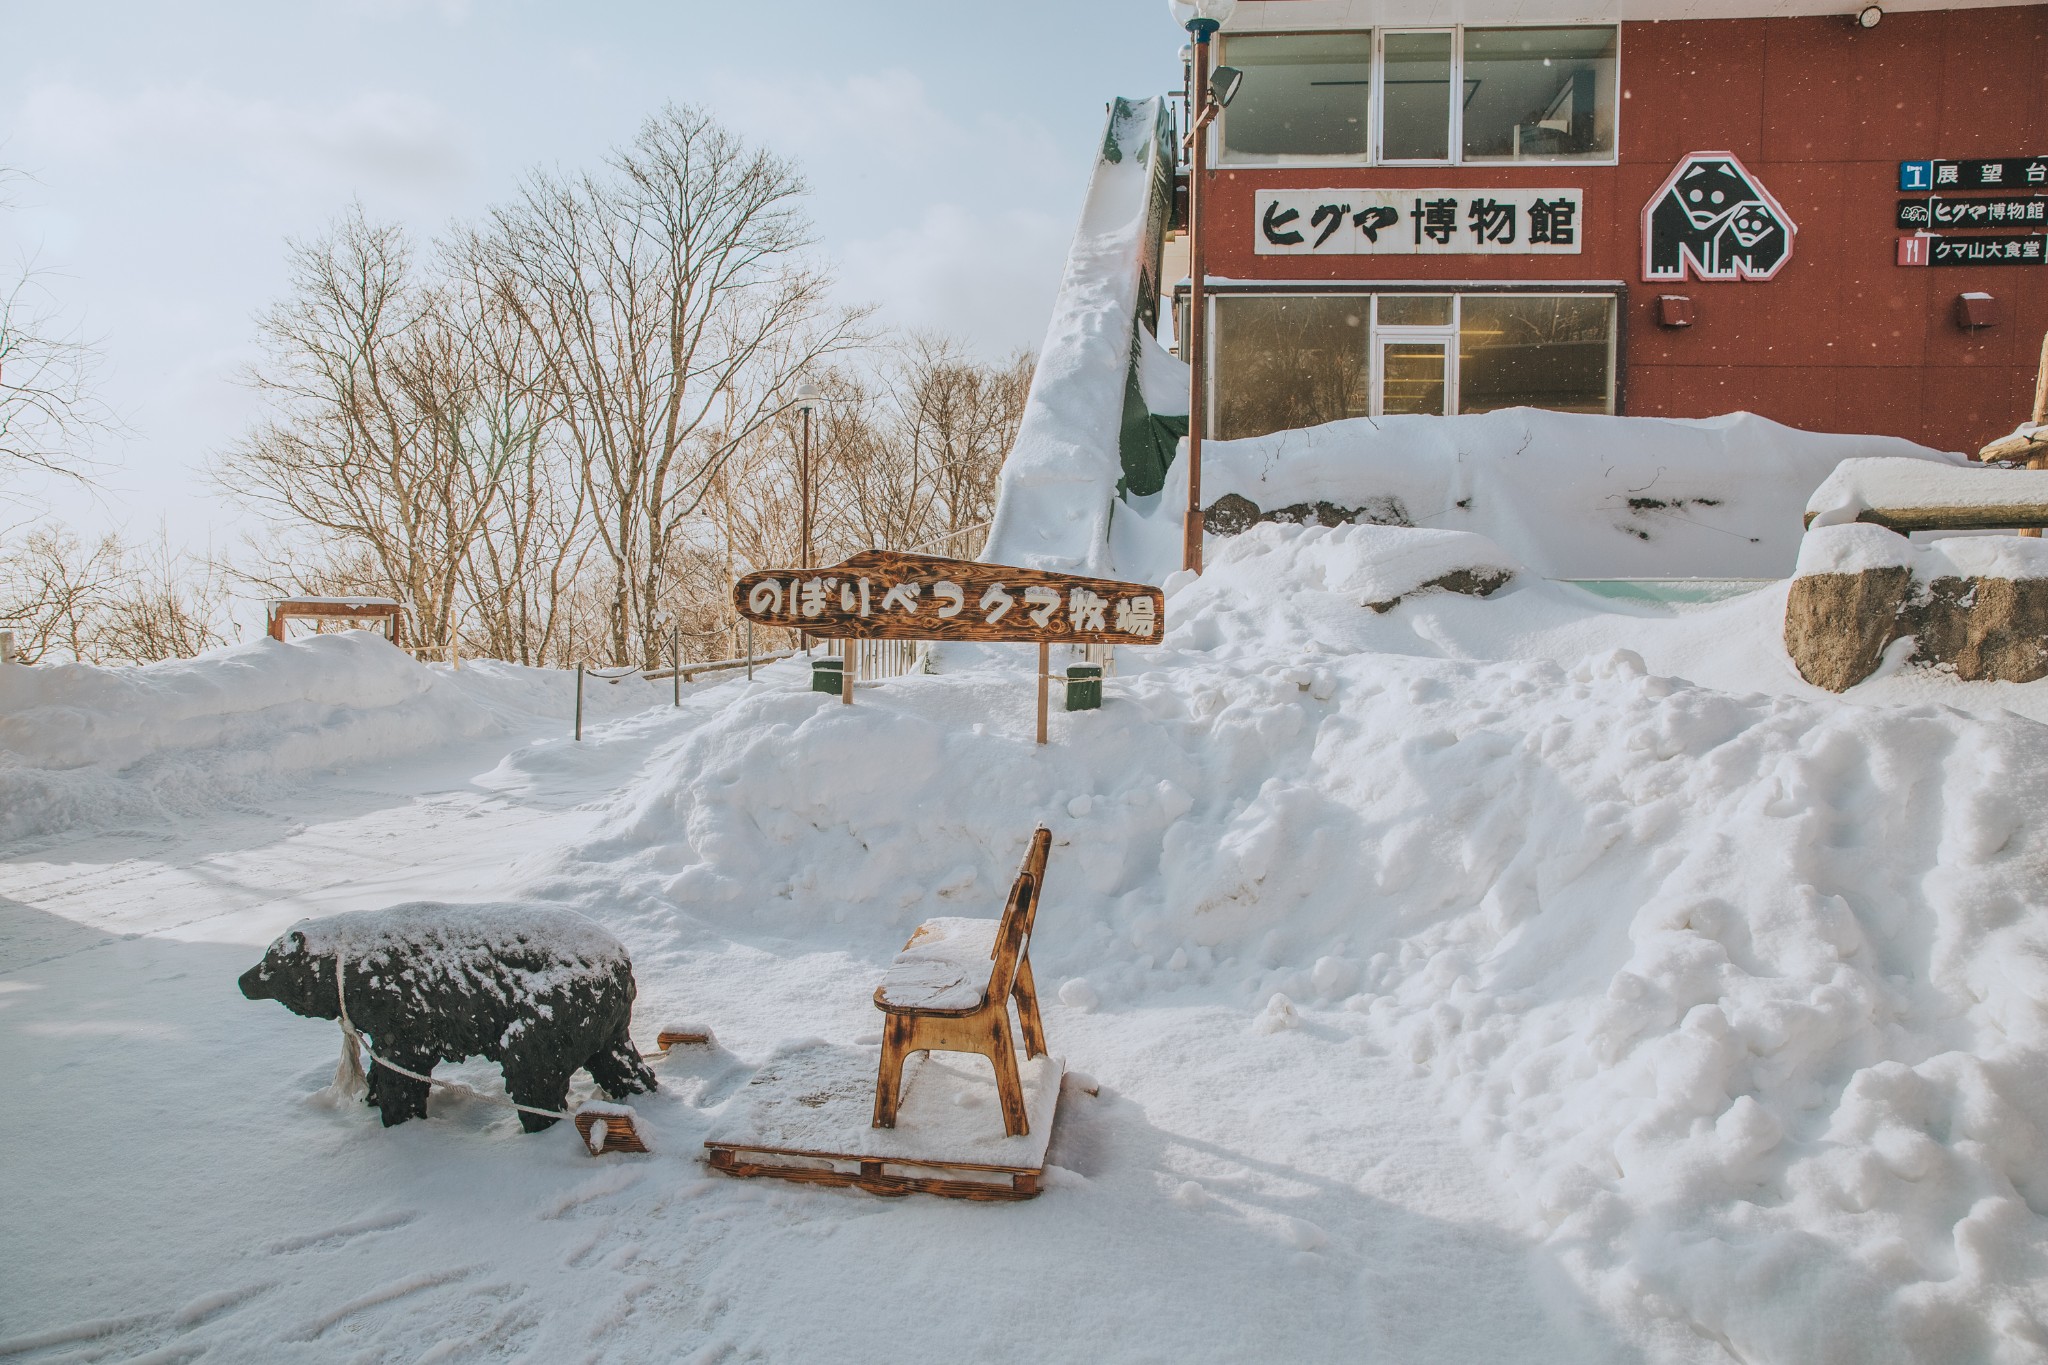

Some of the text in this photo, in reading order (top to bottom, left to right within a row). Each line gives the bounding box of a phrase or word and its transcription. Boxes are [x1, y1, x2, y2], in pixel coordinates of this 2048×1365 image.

[1937, 162, 2047, 184] 展望台
[1935, 201, 2044, 222] ヒグマ博物館
[1262, 197, 1574, 250] ヒグマ博物館
[1935, 241, 2040, 259] クマ山大食堂
[748, 576, 1156, 637] のぼりべつクマ牧場
